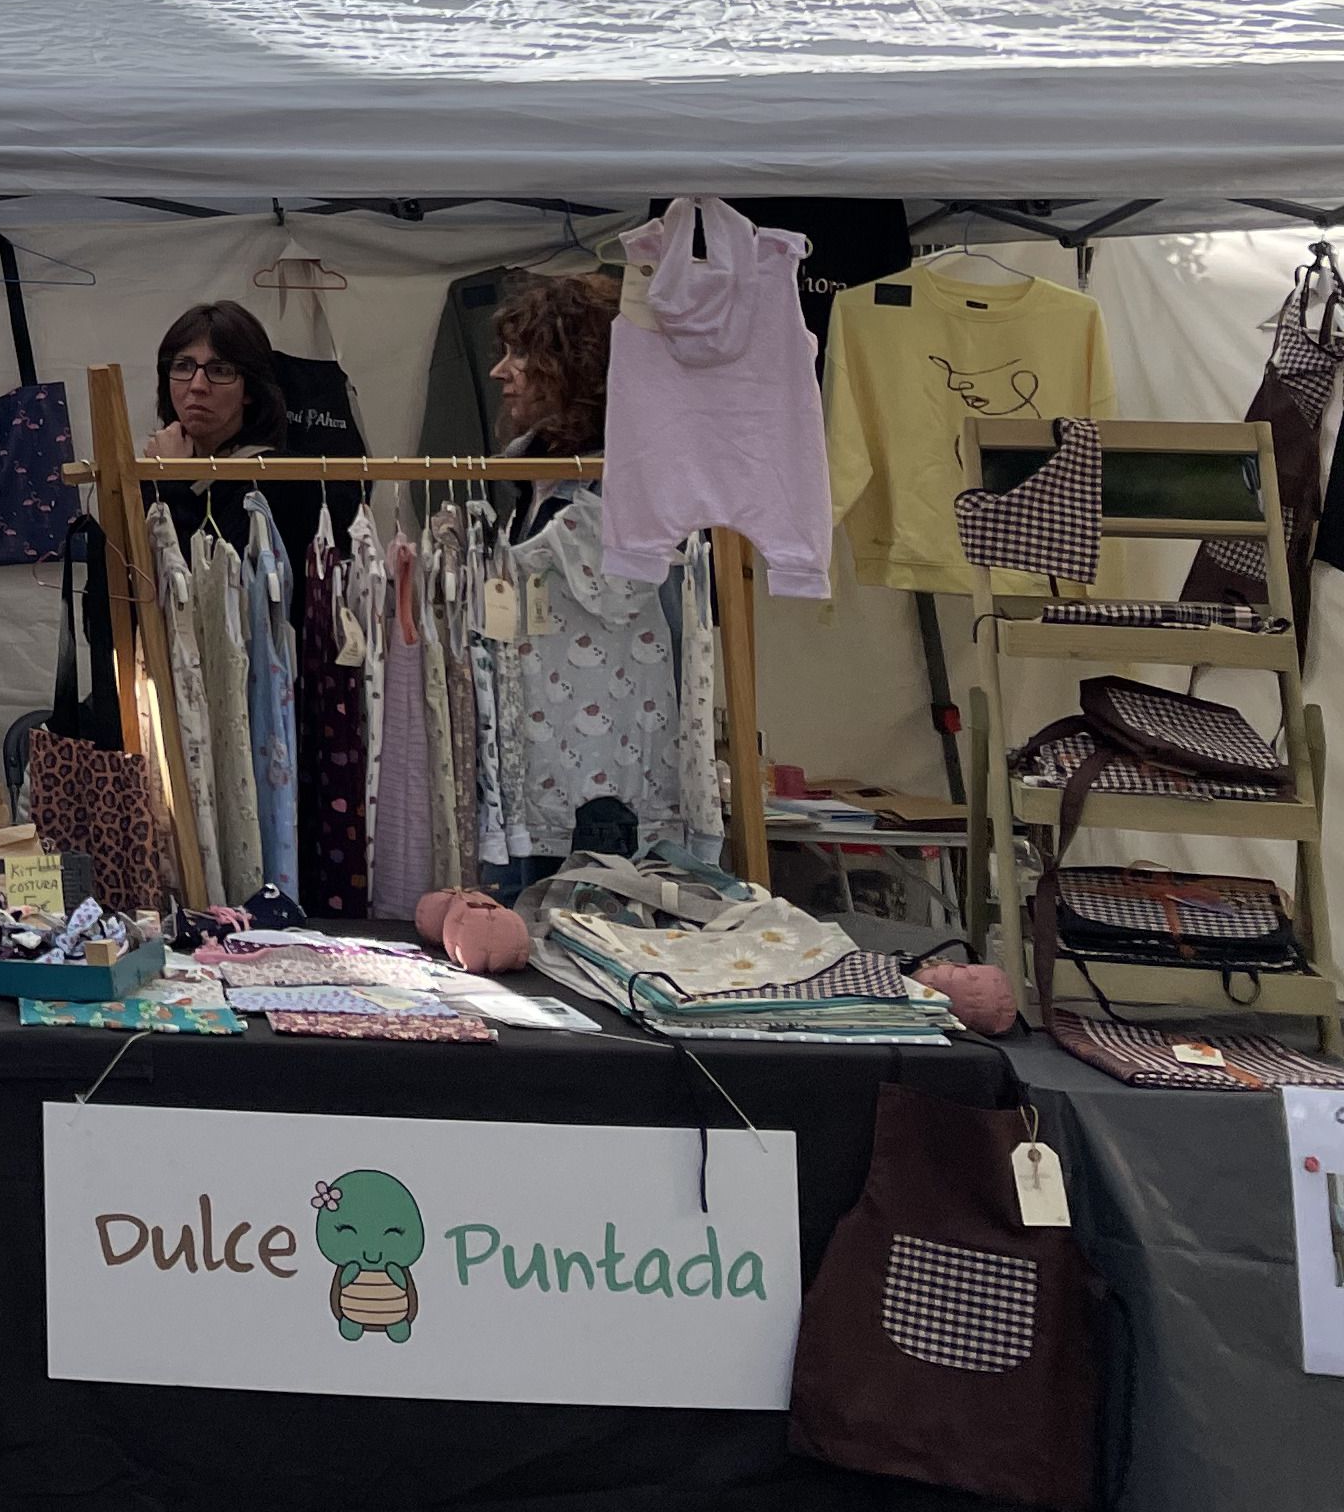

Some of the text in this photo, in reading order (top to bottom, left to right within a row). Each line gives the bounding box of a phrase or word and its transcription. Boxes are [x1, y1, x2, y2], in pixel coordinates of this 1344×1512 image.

[286, 409, 304, 425] quí
[8, 879, 58, 894] COSTURA
[95, 1193, 767, 1301] Dulce Puntada
